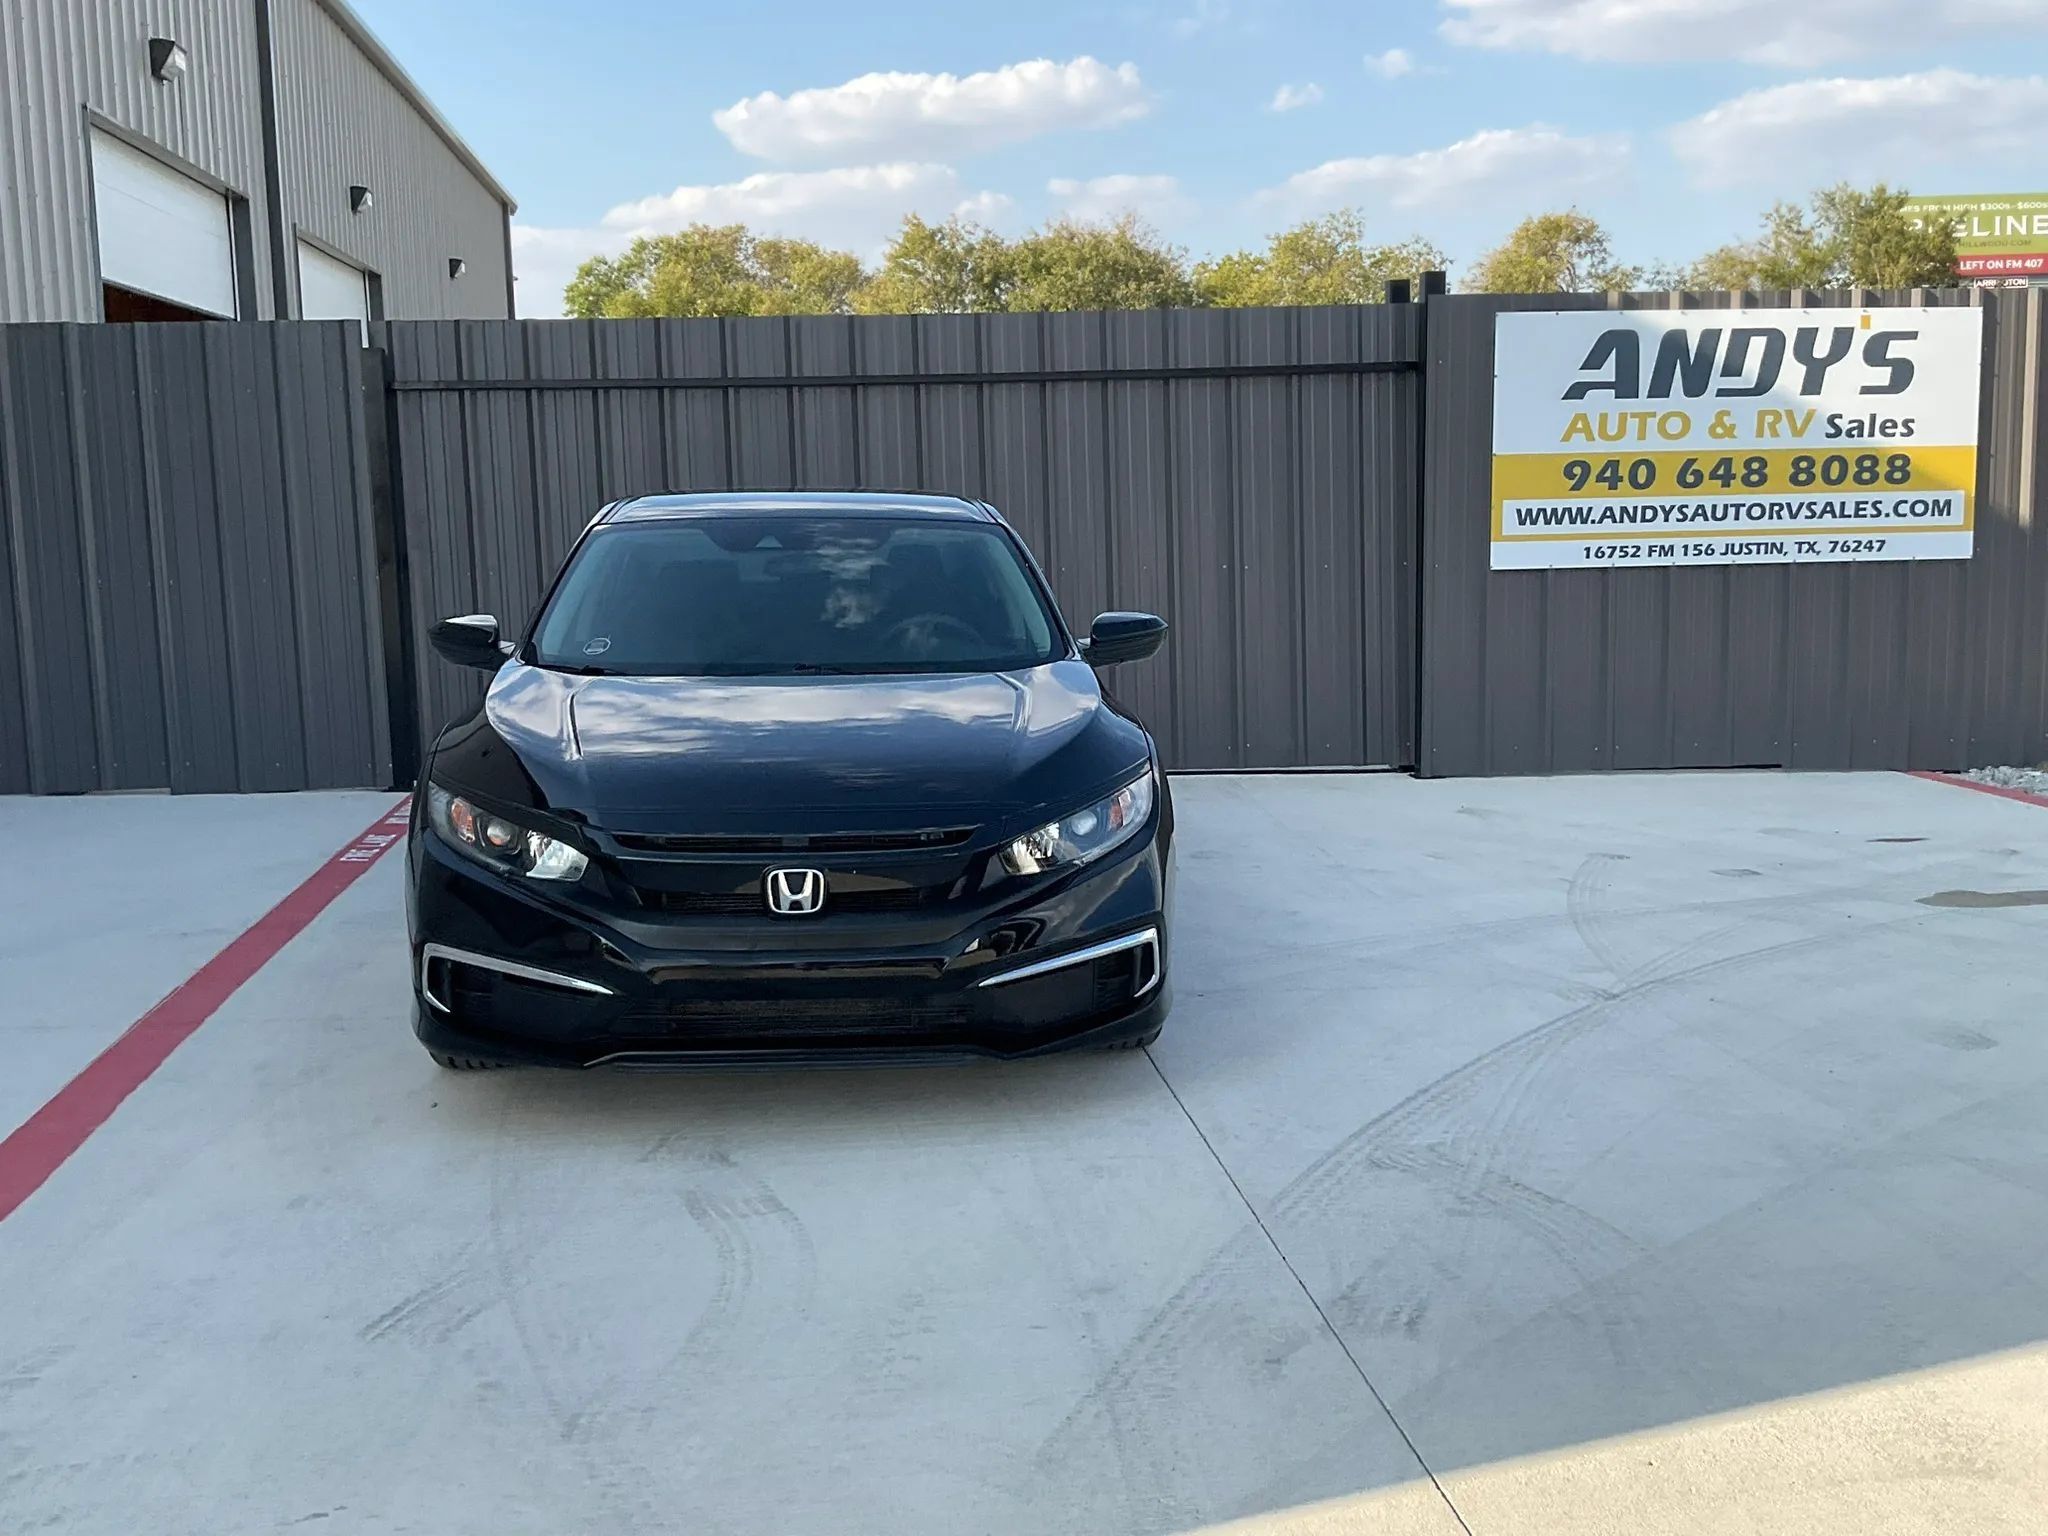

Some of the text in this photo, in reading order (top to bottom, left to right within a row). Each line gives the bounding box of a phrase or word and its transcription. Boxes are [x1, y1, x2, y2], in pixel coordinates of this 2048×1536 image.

[1960, 258, 2044, 270] LEFT ON FM 407
[1561, 315, 1919, 400] ANDY'S
[1560, 408, 1915, 442] AUTO & RV Sales
[1563, 453, 1911, 491] 940 648 8088
[1515, 498, 1952, 526] WWW.ANDYSAUTORVSALES.COM
[1583, 539, 1886, 560] 16752 FM 156 JUSTIN, TX, 76247
